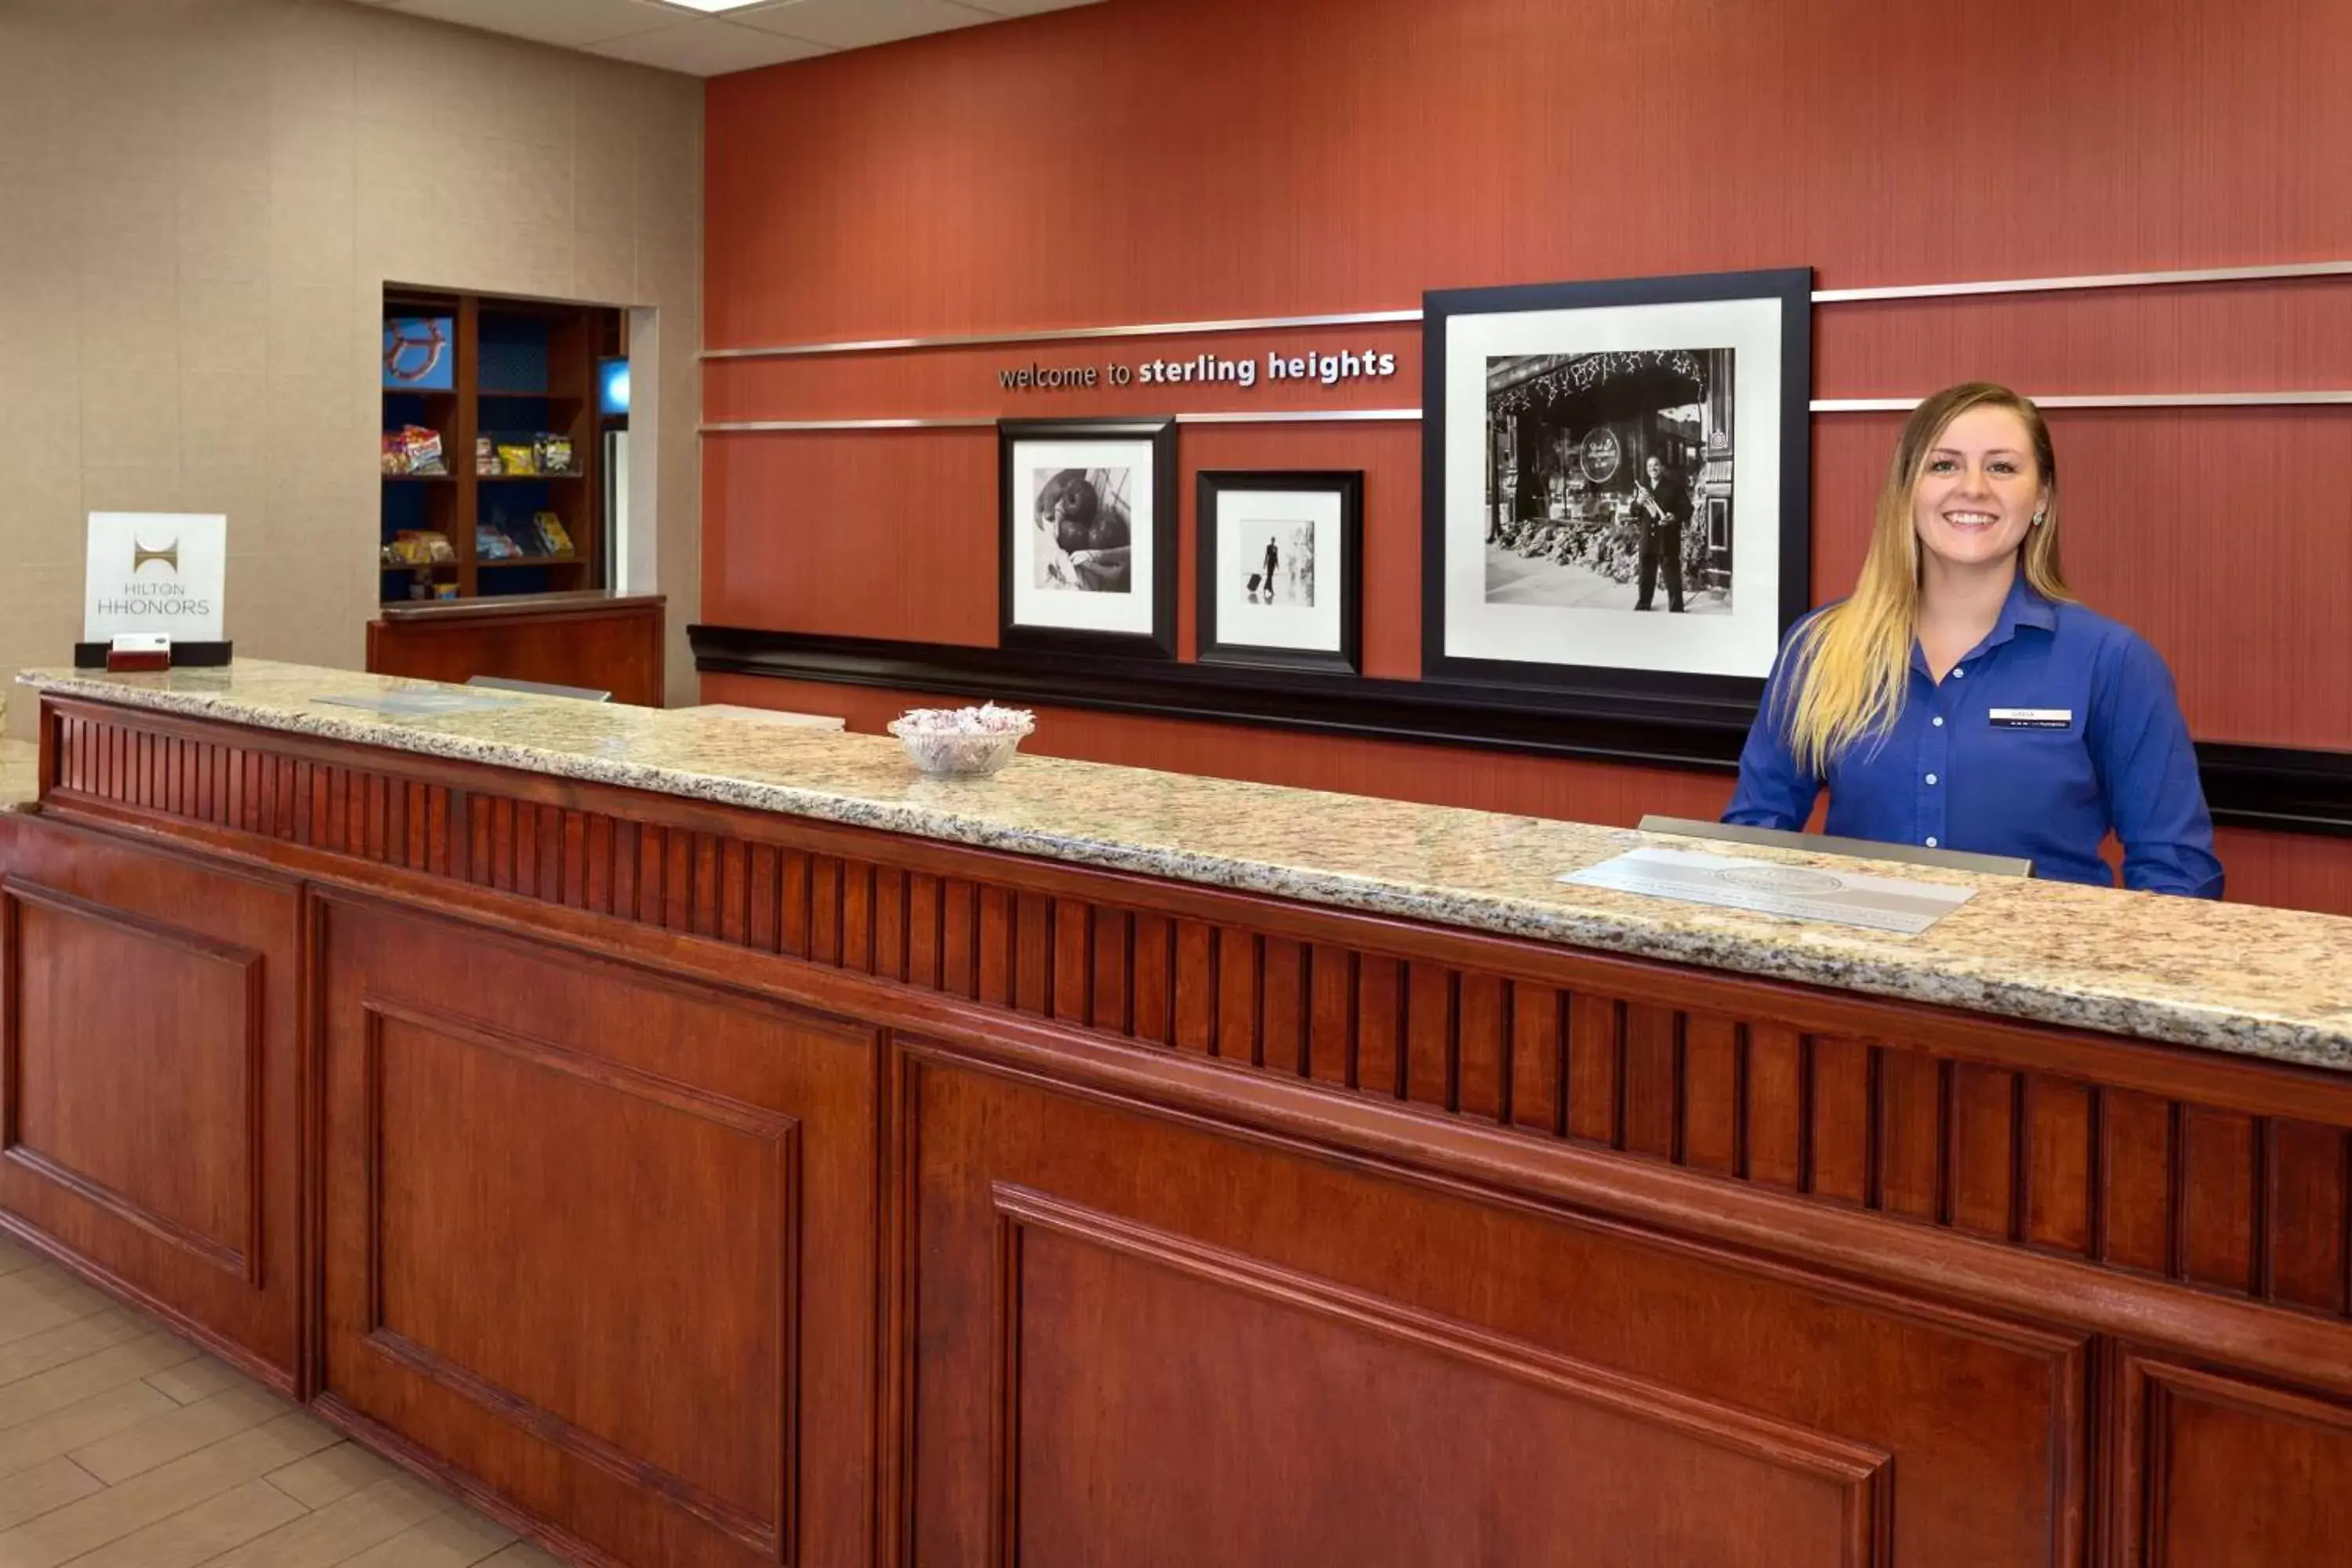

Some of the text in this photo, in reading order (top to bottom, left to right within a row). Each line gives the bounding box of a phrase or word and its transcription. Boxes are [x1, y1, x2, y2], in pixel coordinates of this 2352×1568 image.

[998, 349, 1396, 388] welcome to sterling heights
[123, 583, 186, 596] HILTON
[97, 599, 210, 615] HHONORS
